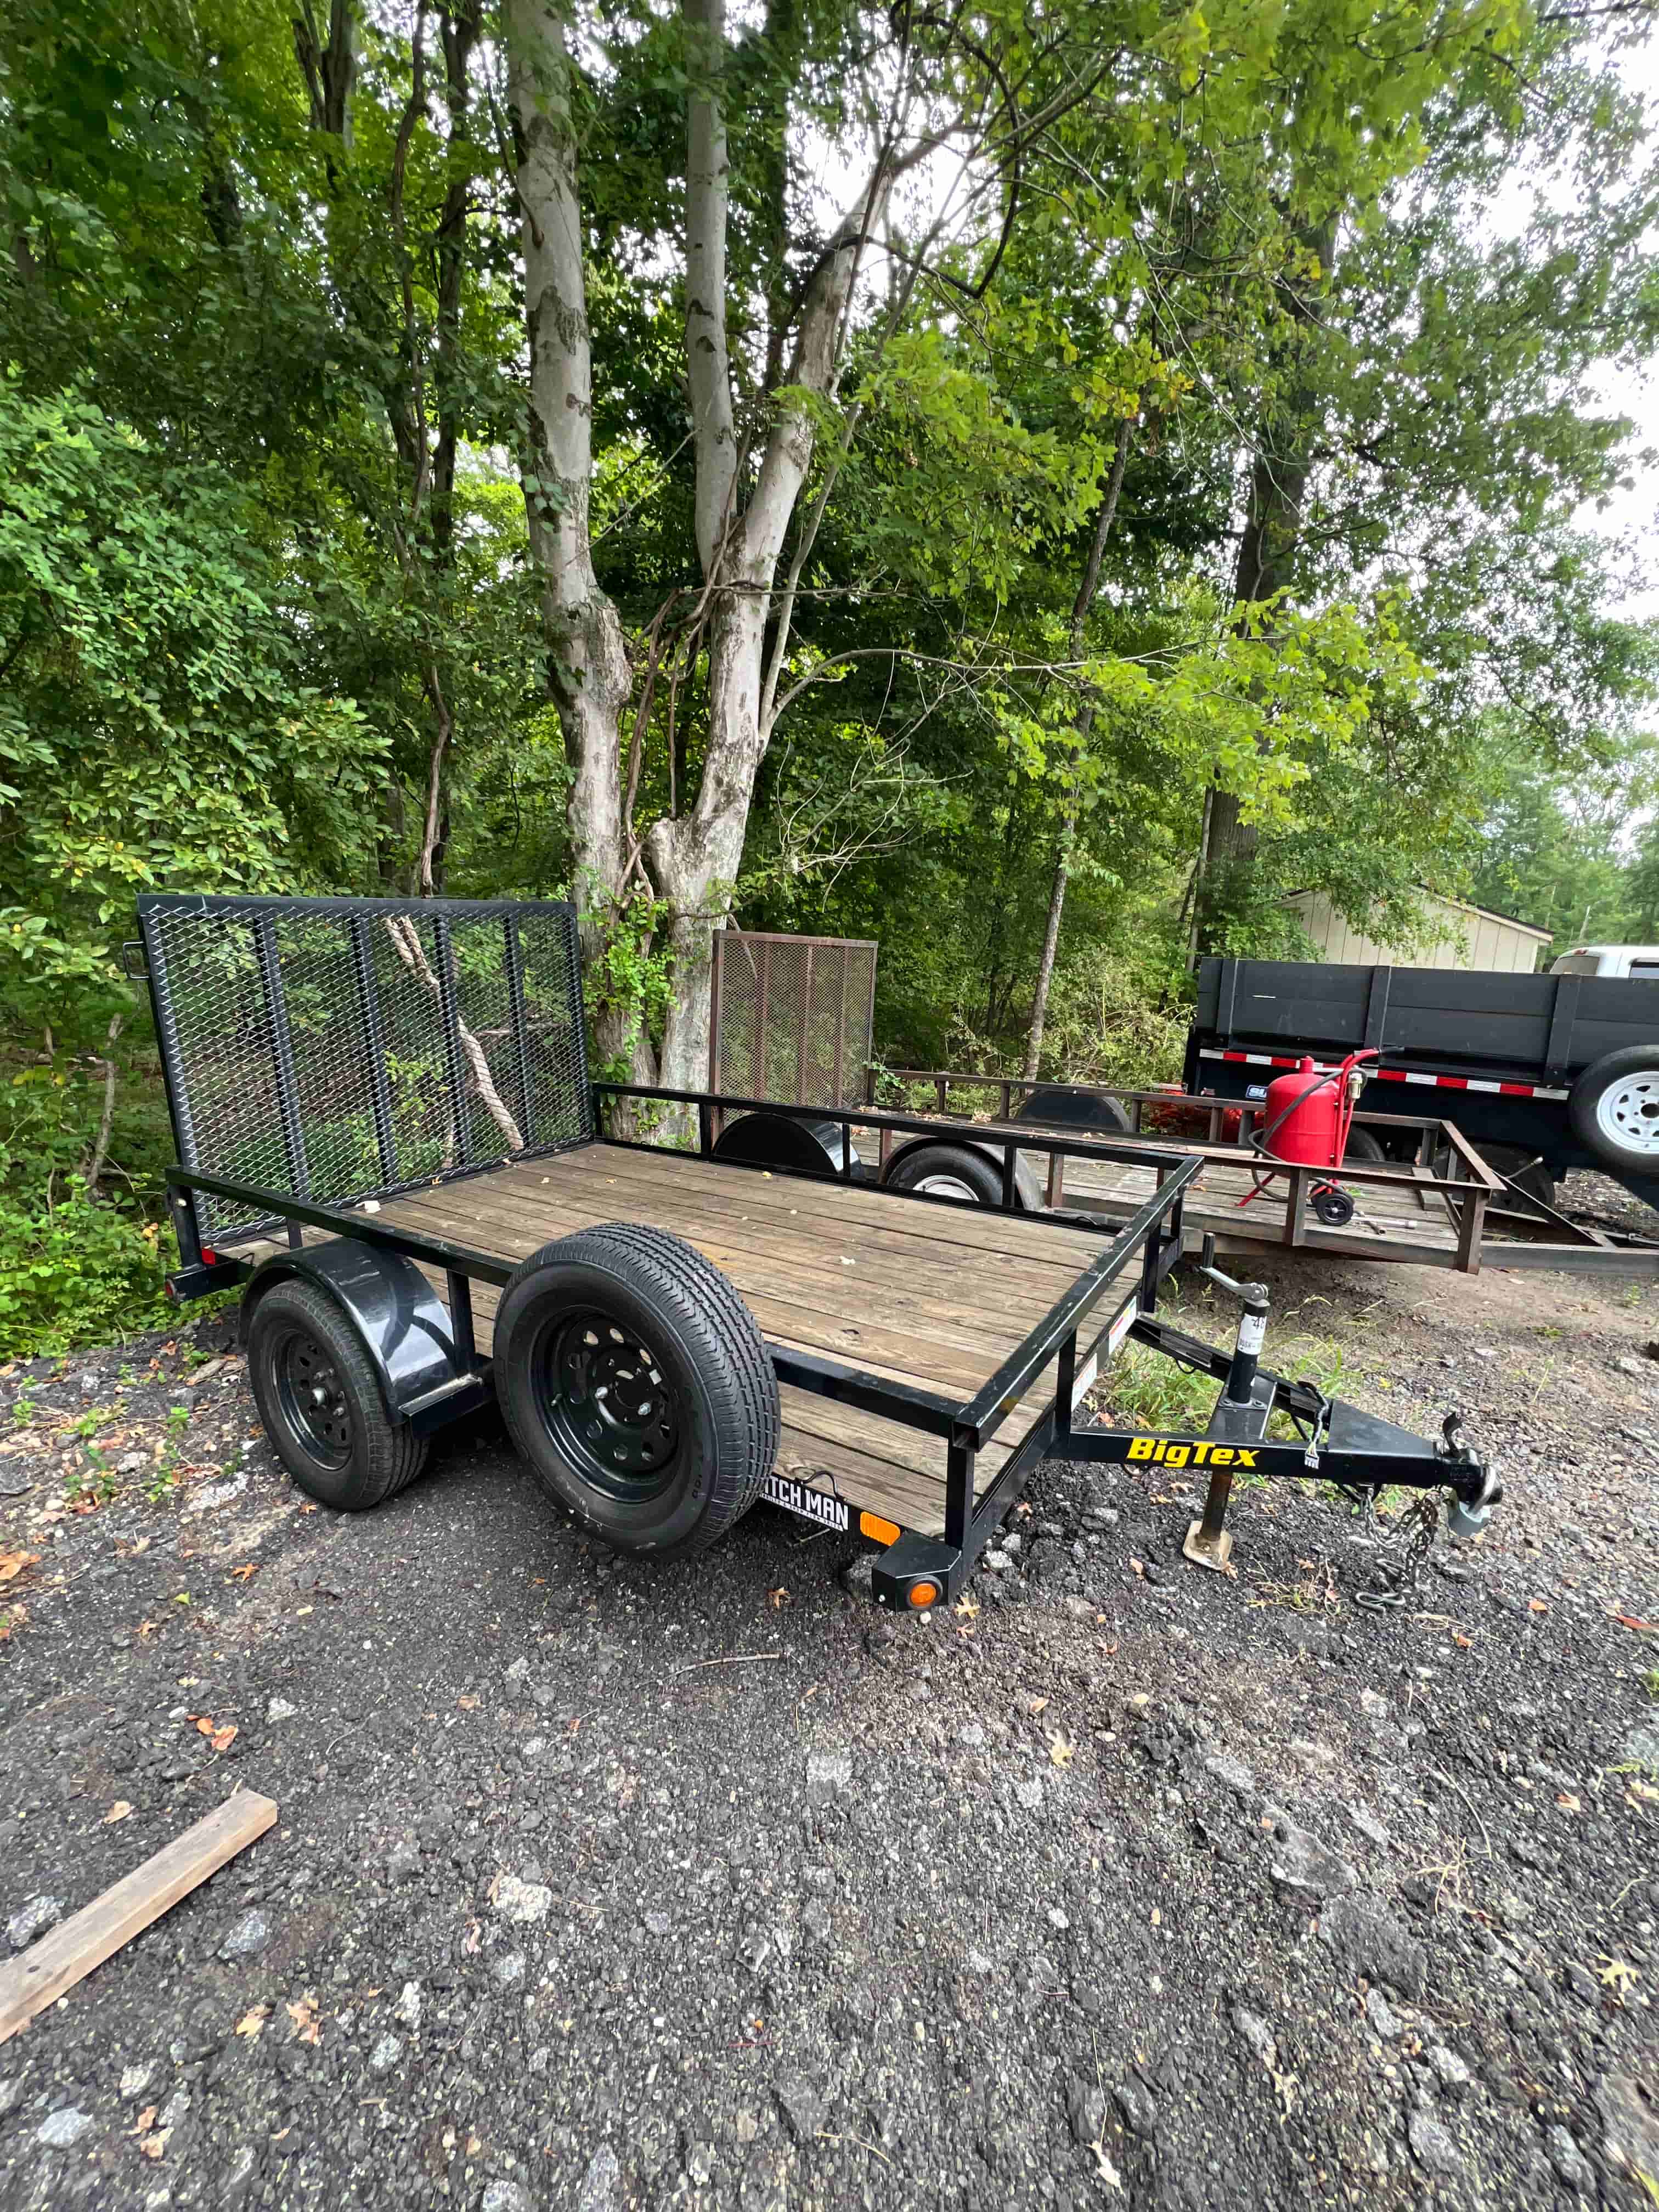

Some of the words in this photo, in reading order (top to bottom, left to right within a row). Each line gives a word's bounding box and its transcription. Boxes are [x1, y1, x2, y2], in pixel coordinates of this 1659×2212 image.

[1127, 1437, 1260, 1468] BigTex
[763, 1475, 802, 1508] ITCH
[805, 1489, 849, 1531] MAN
